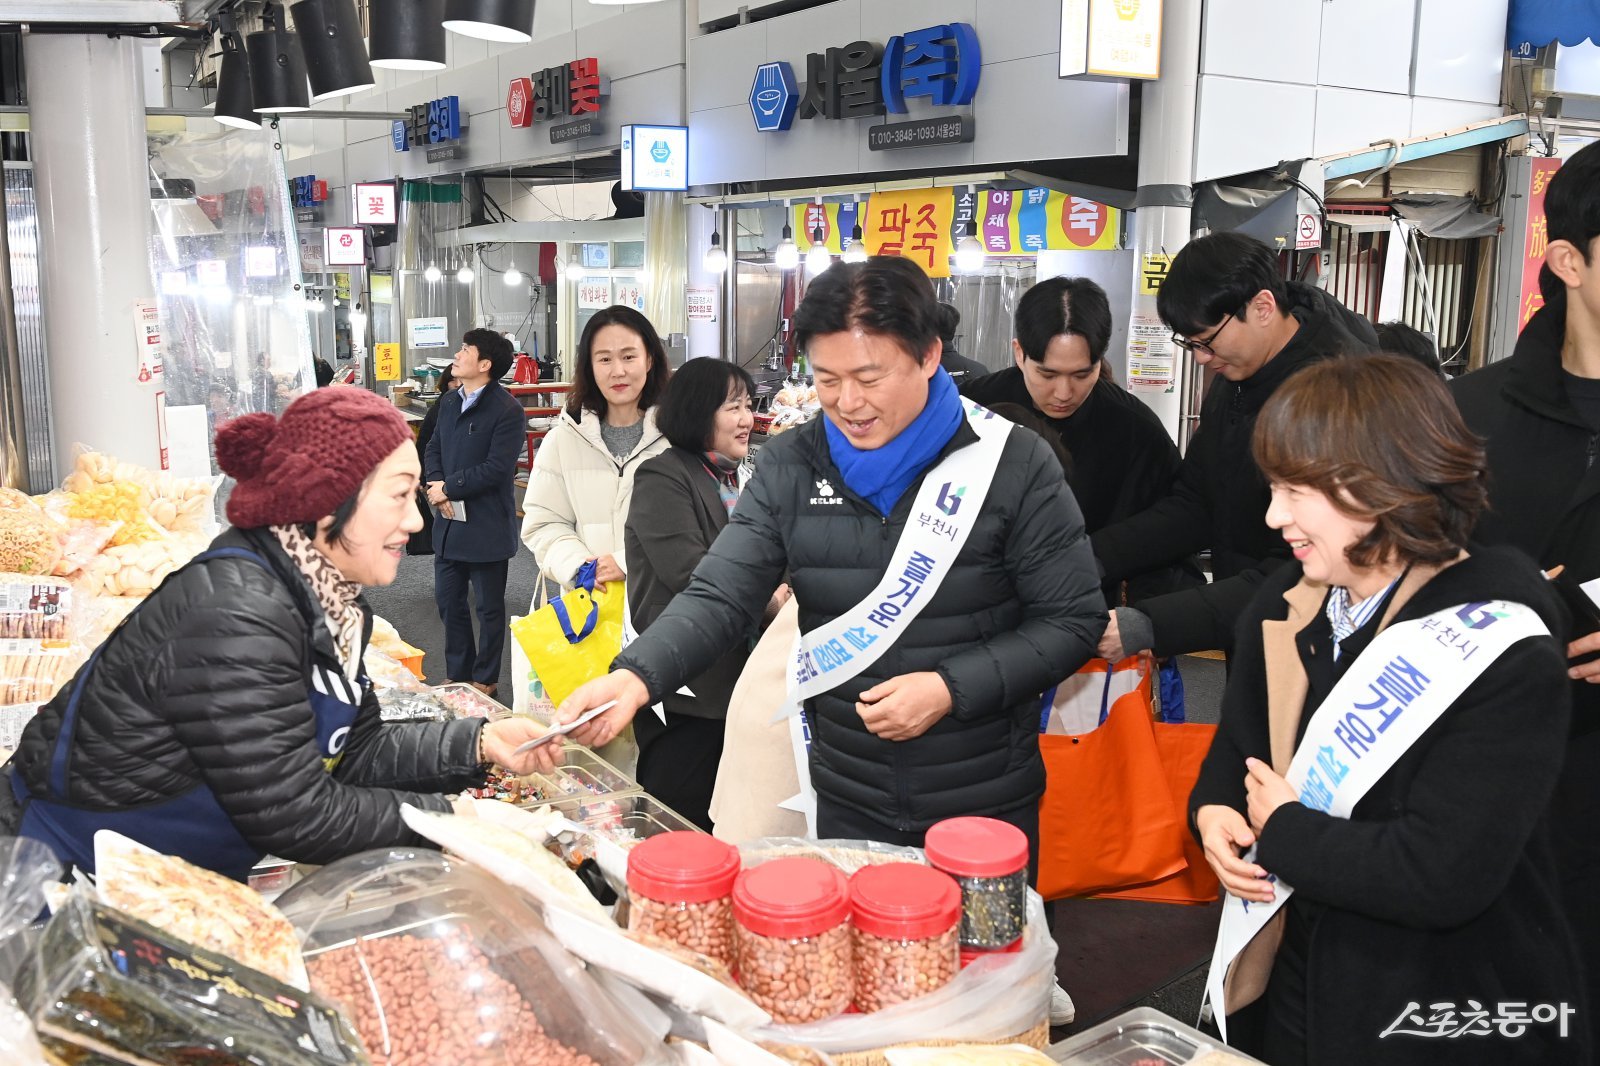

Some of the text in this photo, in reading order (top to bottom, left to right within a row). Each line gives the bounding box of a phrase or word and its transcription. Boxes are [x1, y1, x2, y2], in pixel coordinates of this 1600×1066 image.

[531, 57, 600, 122] 장미꽃
[800, 22, 980, 119] 서울(죽)
[871, 122, 962, 145] T.010-3848-1093 서울상회
[368, 196, 384, 216] 꽃
[1068, 196, 1099, 237] 죽
[580, 286, 609, 304] 개업화분
[809, 497, 844, 506] KELME
[916, 511, 959, 543] 부천시
[867, 550, 936, 629] 즐거운
[812, 637, 855, 674] 명절
[842, 625, 879, 652] 설
[1418, 617, 1481, 662] 부천시
[1334, 654, 1432, 760] 즐거운
[1316, 744, 1351, 790] 설
